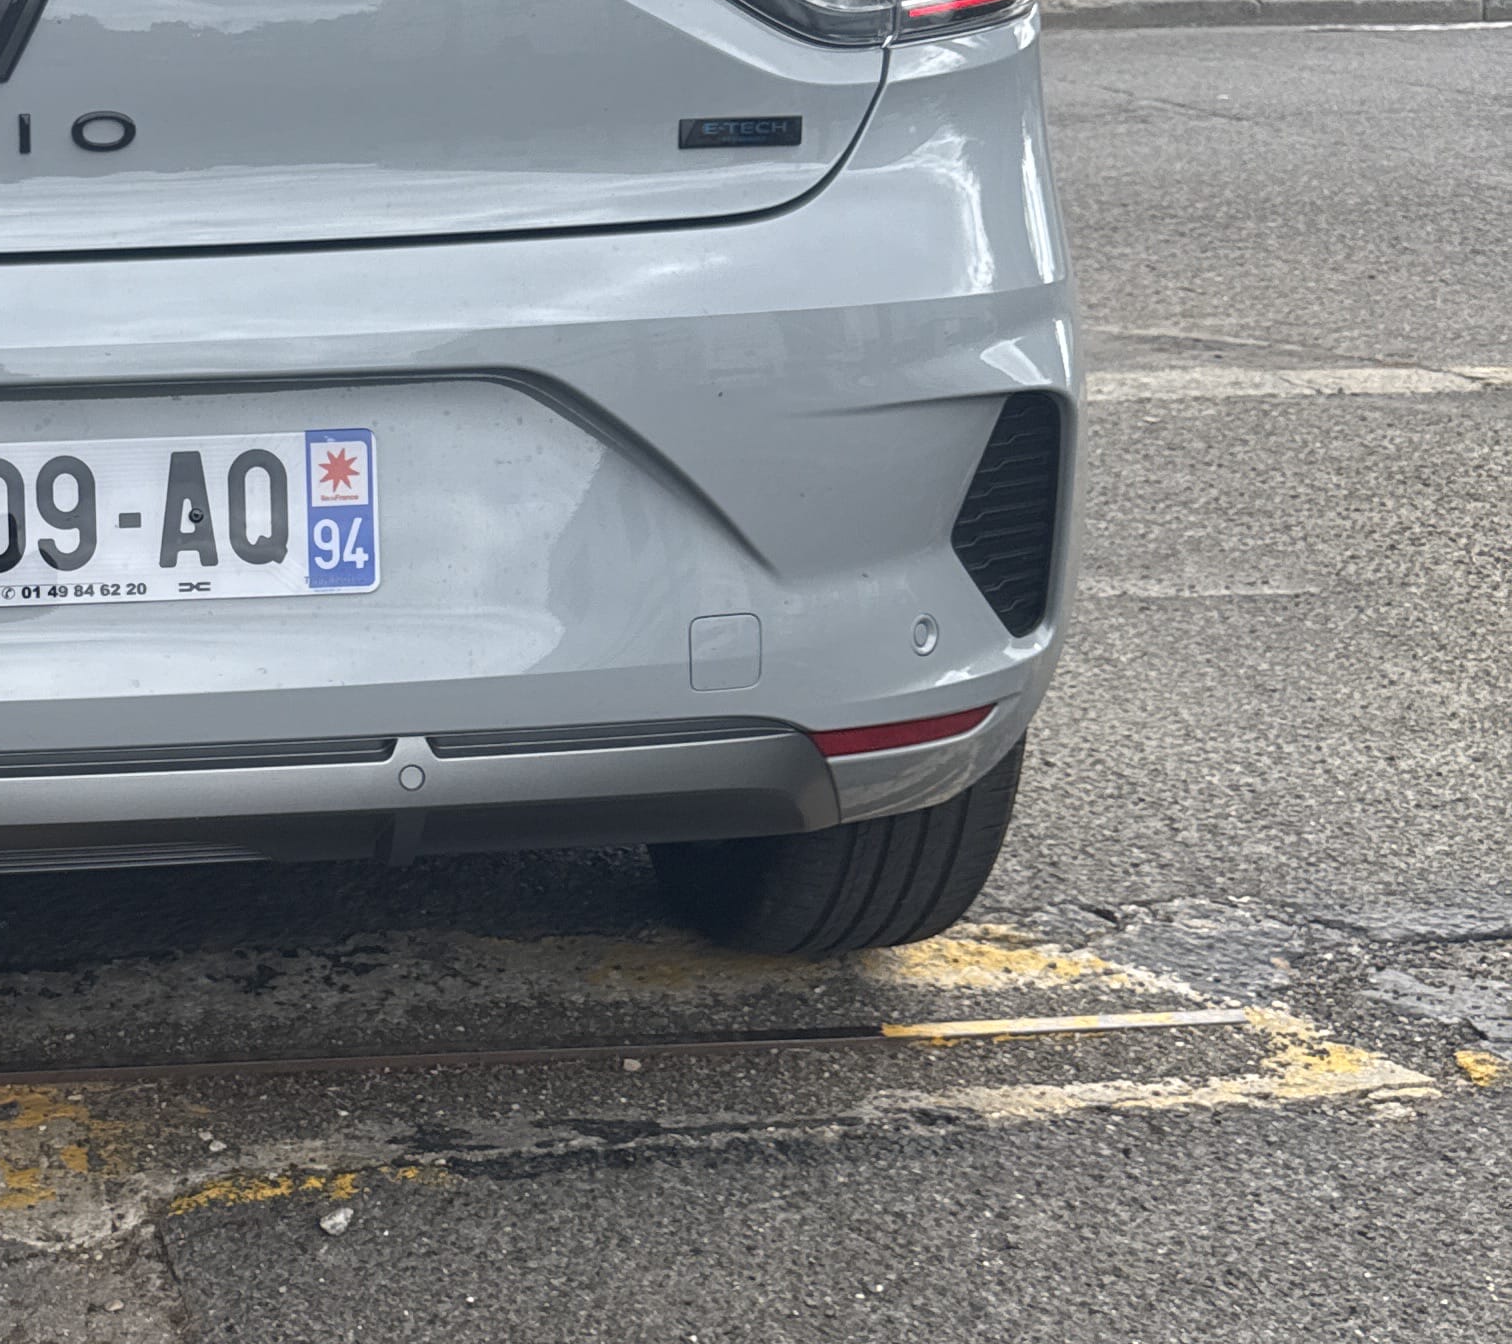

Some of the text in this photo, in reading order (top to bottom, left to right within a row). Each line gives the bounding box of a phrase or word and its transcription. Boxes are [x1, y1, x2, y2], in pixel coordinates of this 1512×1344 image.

[702, 122, 787, 135] E-TECH
[313, 517, 369, 570] 94
[21, 586, 40, 599] 01
[48, 585, 68, 597] 49
[74, 584, 95, 597] 84
[100, 583, 121, 596] 62
[126, 582, 147, 595] 20
